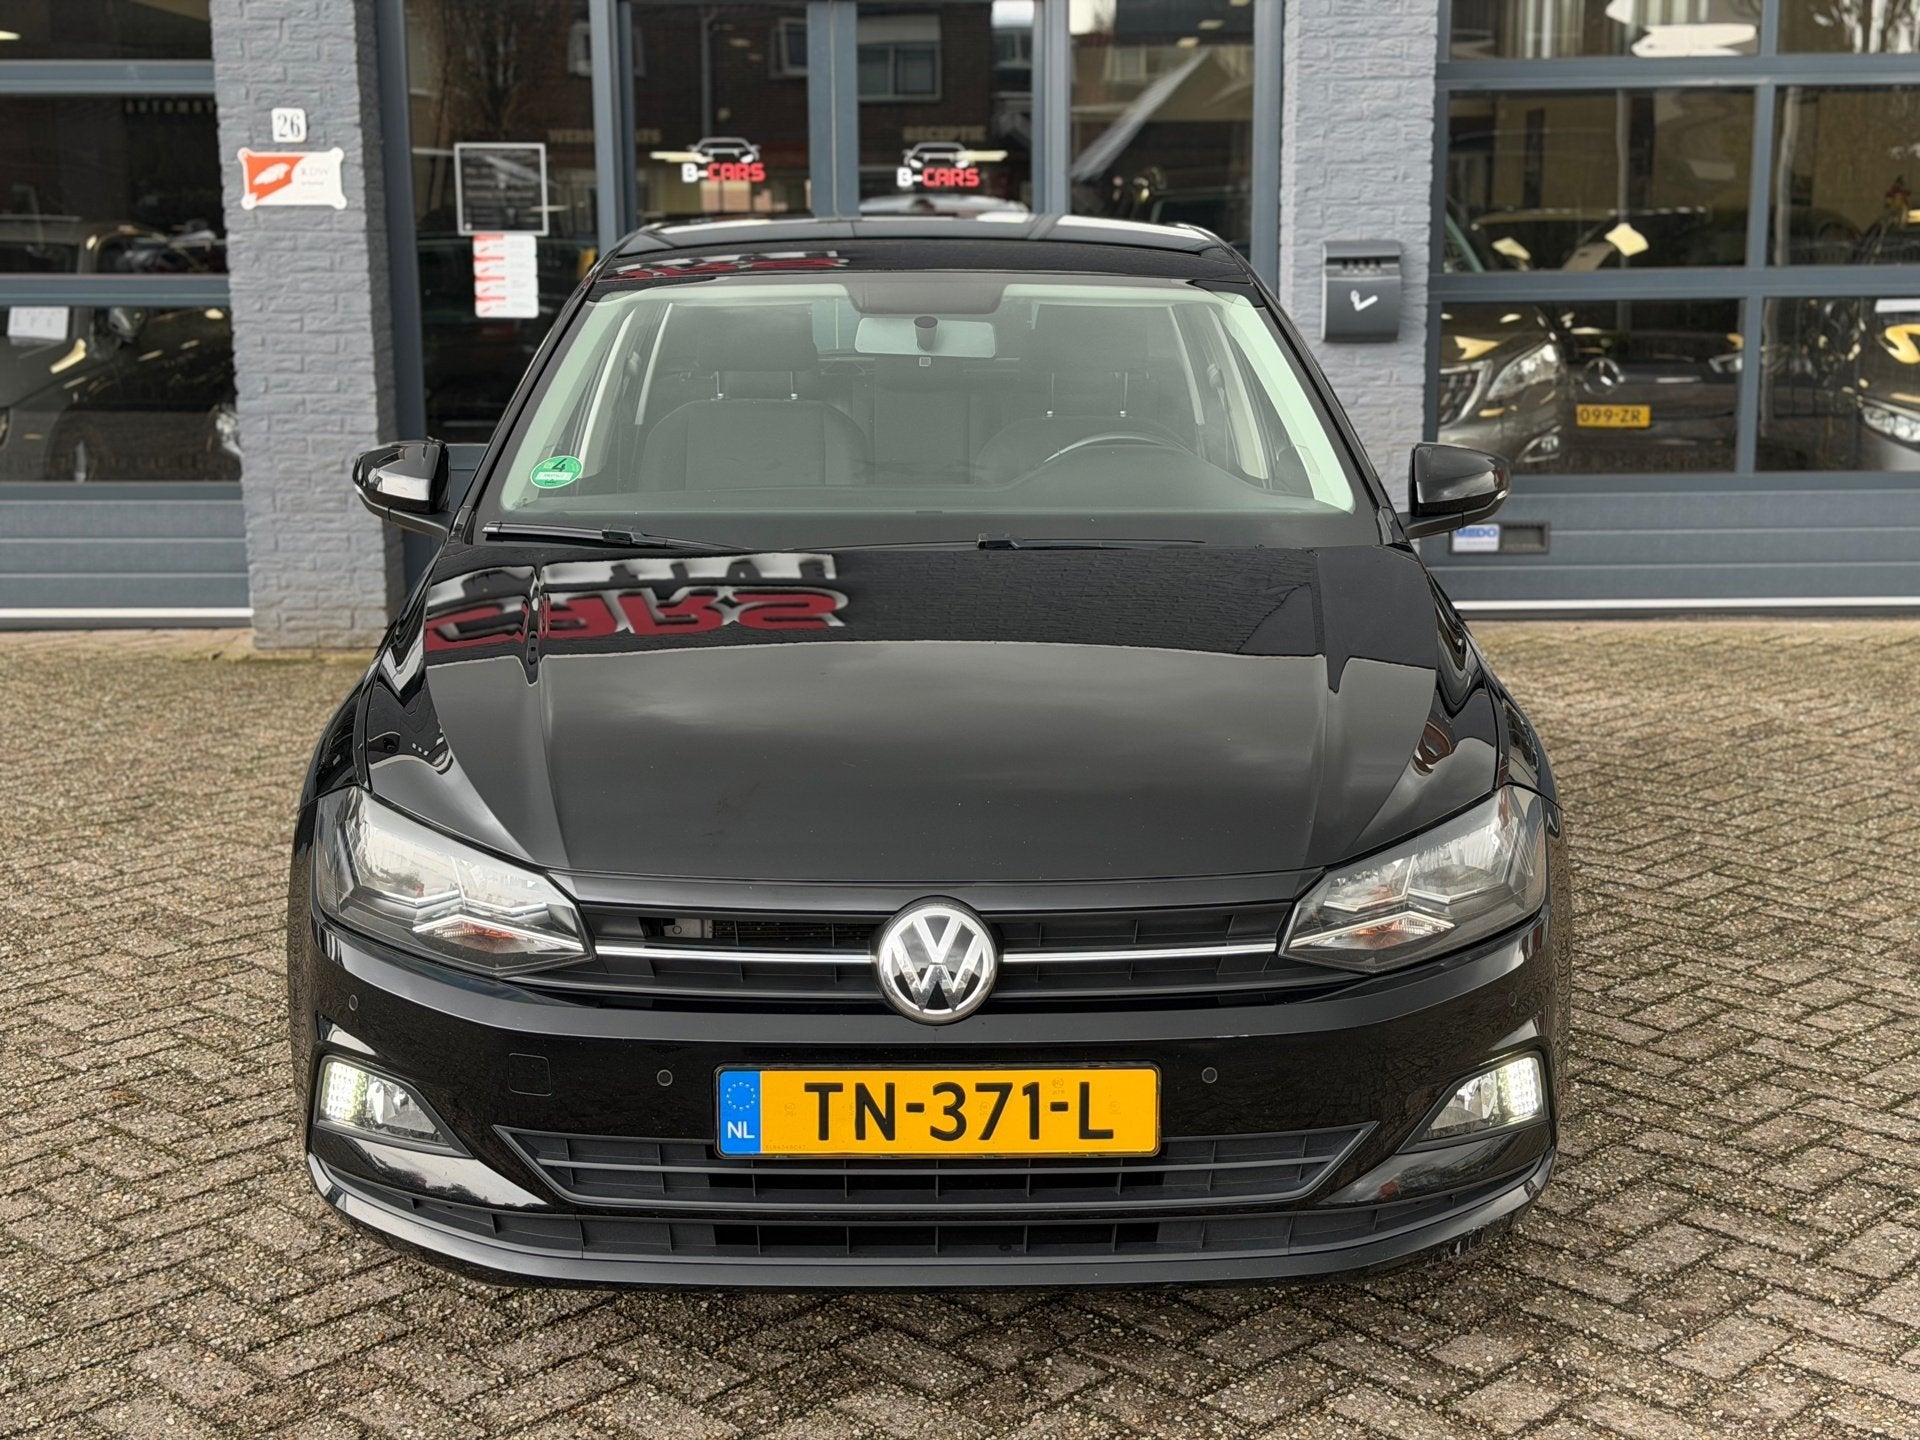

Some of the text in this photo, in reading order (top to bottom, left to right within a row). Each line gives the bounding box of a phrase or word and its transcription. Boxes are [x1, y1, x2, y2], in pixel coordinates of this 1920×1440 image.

[277, 114, 301, 138] 26
[681, 162, 767, 183] B-CARS
[896, 166, 981, 188] B-CARS
[551, 457, 567, 472] 4
[804, 1080, 1114, 1141] TN-371-L
[728, 1121, 755, 1139] NL
